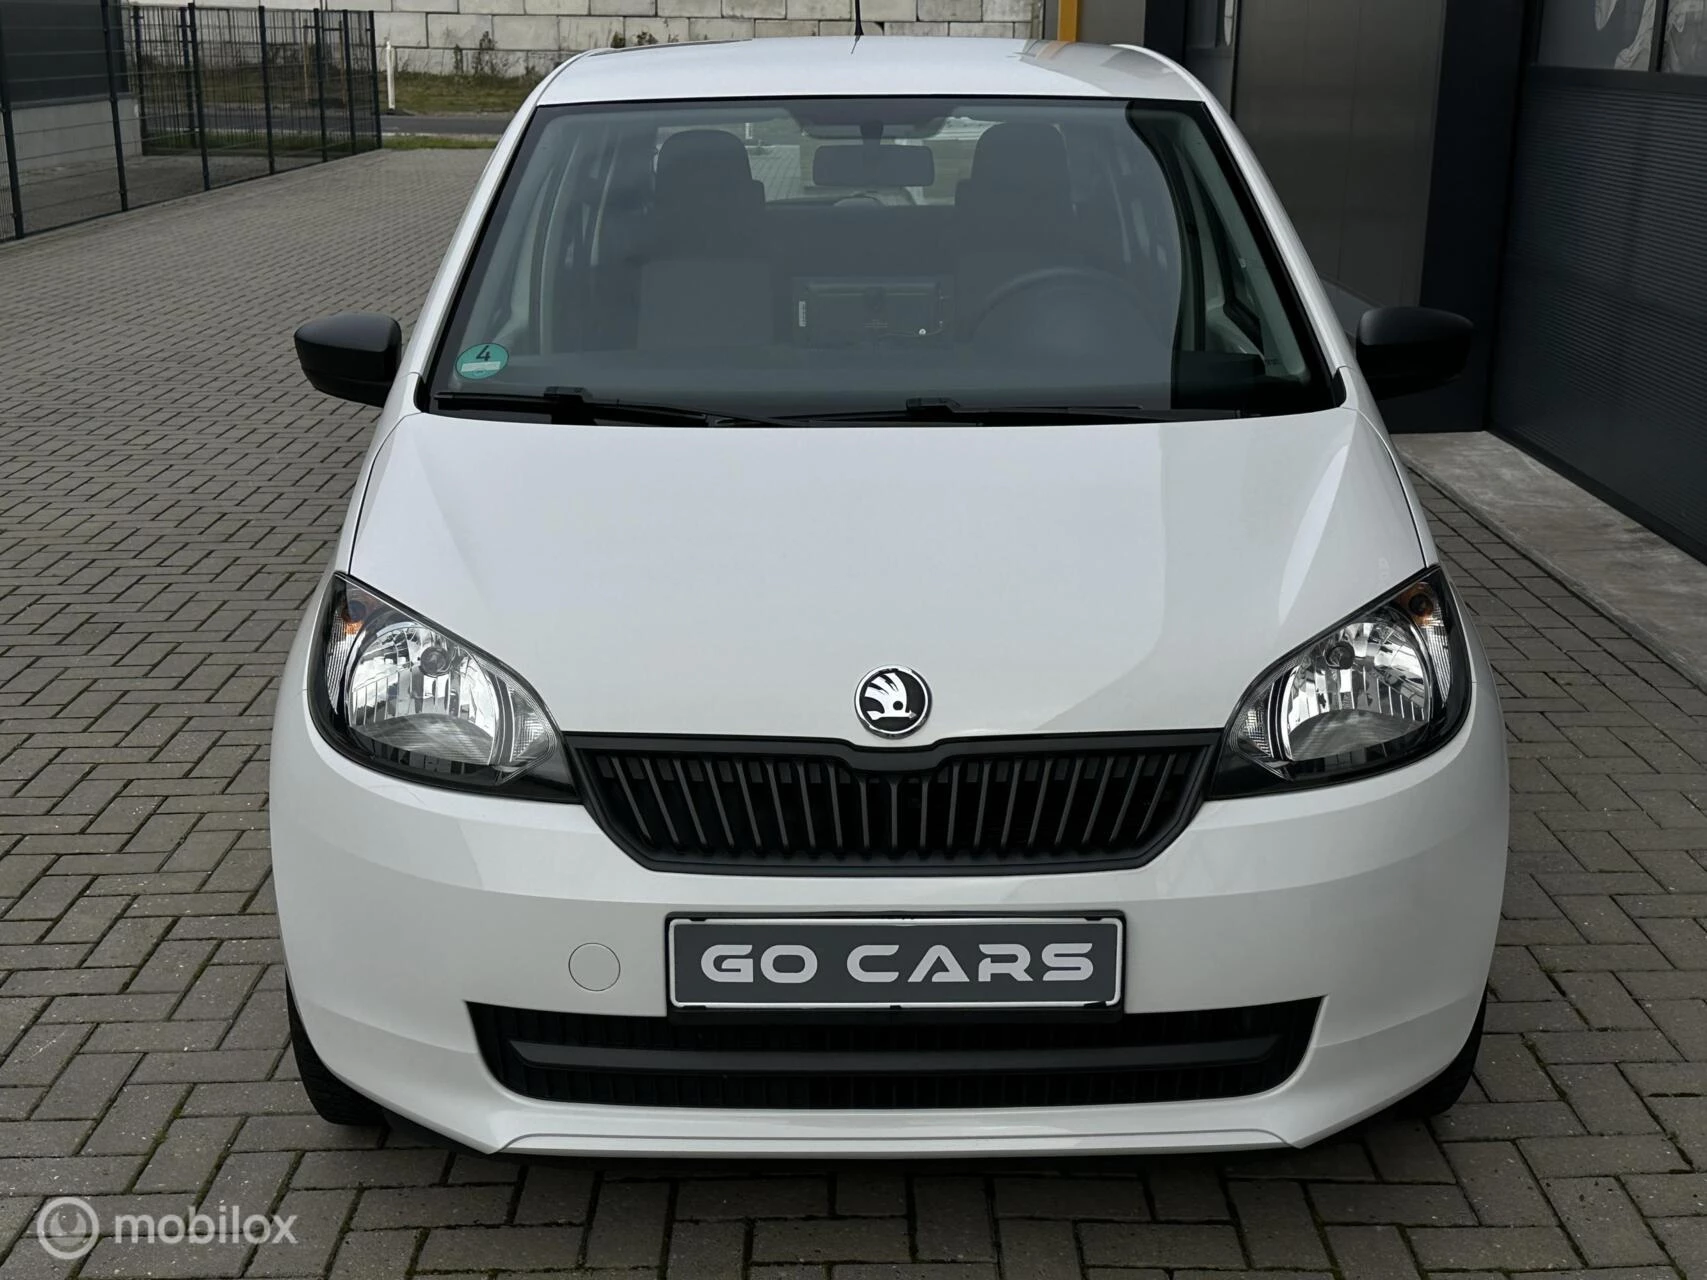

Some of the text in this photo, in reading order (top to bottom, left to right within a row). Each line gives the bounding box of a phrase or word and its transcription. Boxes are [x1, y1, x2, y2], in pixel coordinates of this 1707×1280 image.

[476, 344, 491, 361] 4
[701, 943, 1094, 984] GO CARS
